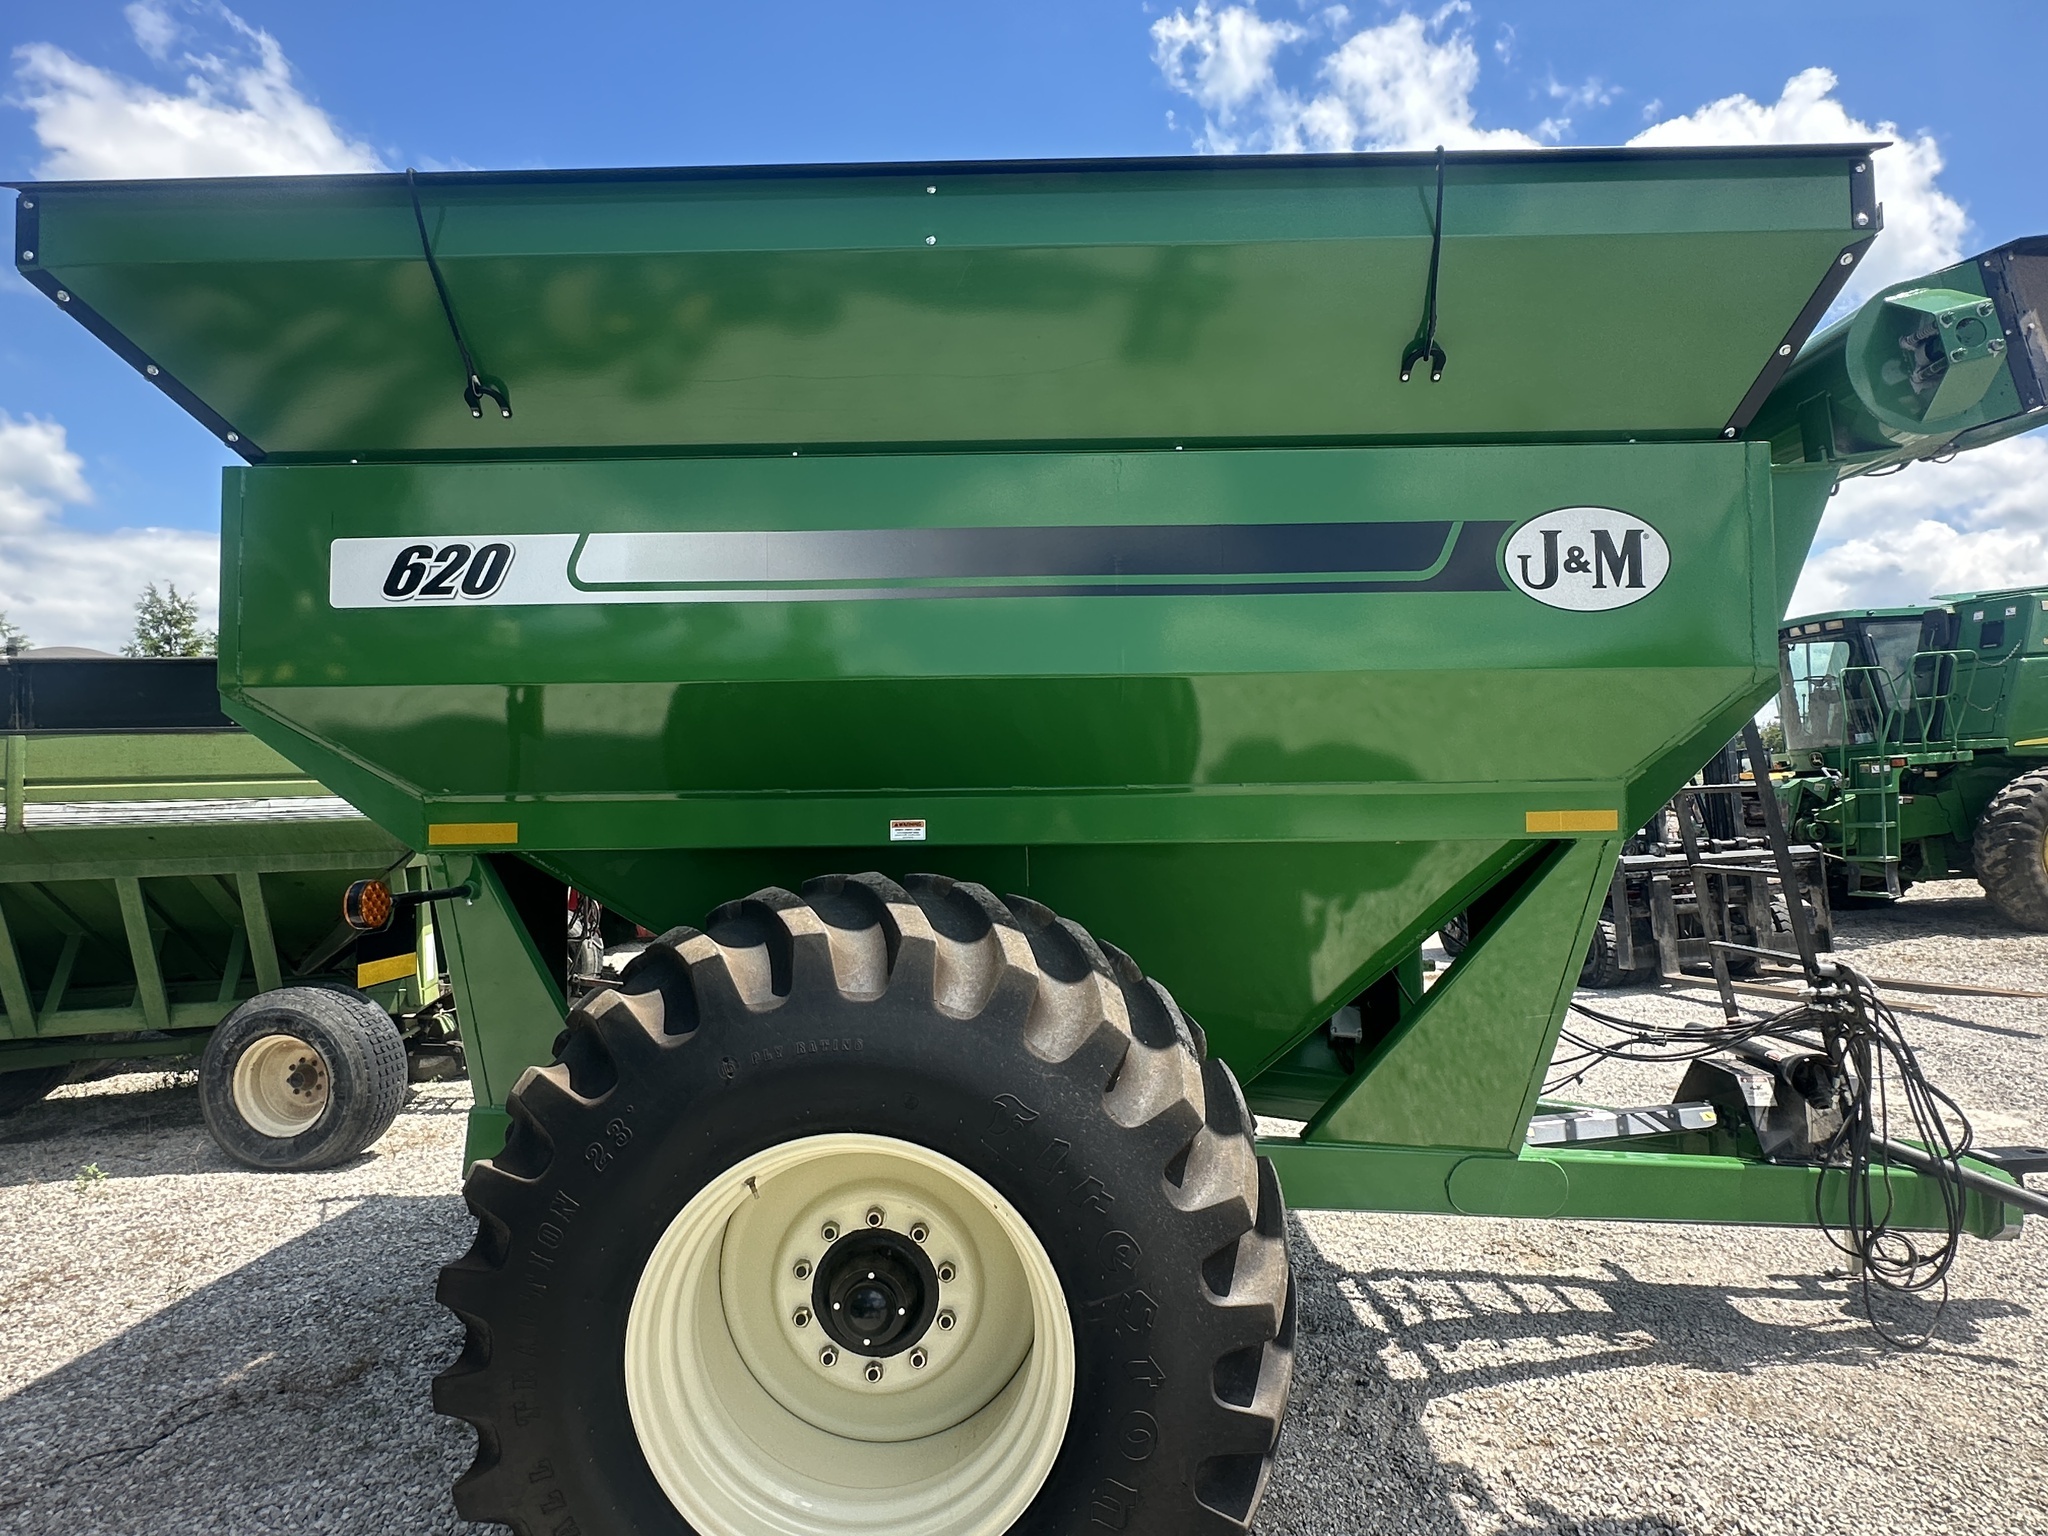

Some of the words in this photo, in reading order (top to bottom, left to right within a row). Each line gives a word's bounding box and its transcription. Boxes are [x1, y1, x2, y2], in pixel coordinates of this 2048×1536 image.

[382, 541, 514, 599] 620
[751, 1045, 784, 1065] PLY
[794, 1037, 864, 1054] RATING
[985, 1092, 1167, 1532] Fireston
